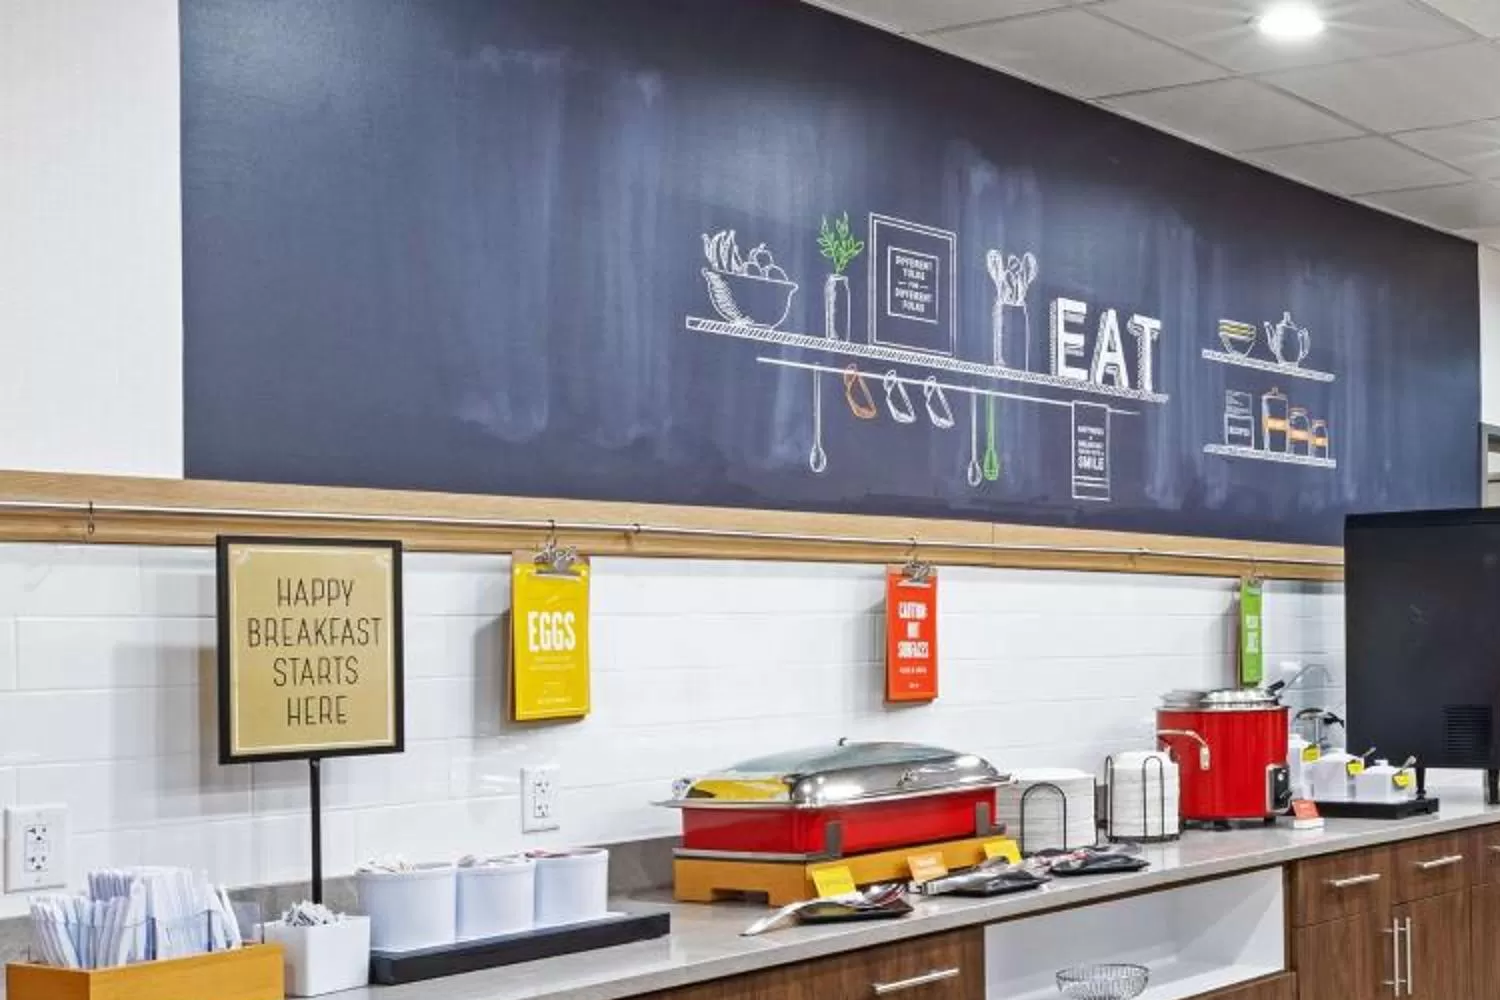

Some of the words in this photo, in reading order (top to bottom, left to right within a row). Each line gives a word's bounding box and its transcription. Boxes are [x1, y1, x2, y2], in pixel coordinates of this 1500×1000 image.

[1050, 297, 1162, 392] EAT
[277, 577, 355, 607] HAPPY
[247, 617, 383, 647] BREAKFAST
[528, 611, 576, 652] EGGS
[272, 656, 359, 687] STARTS
[287, 695, 349, 726] HERE
